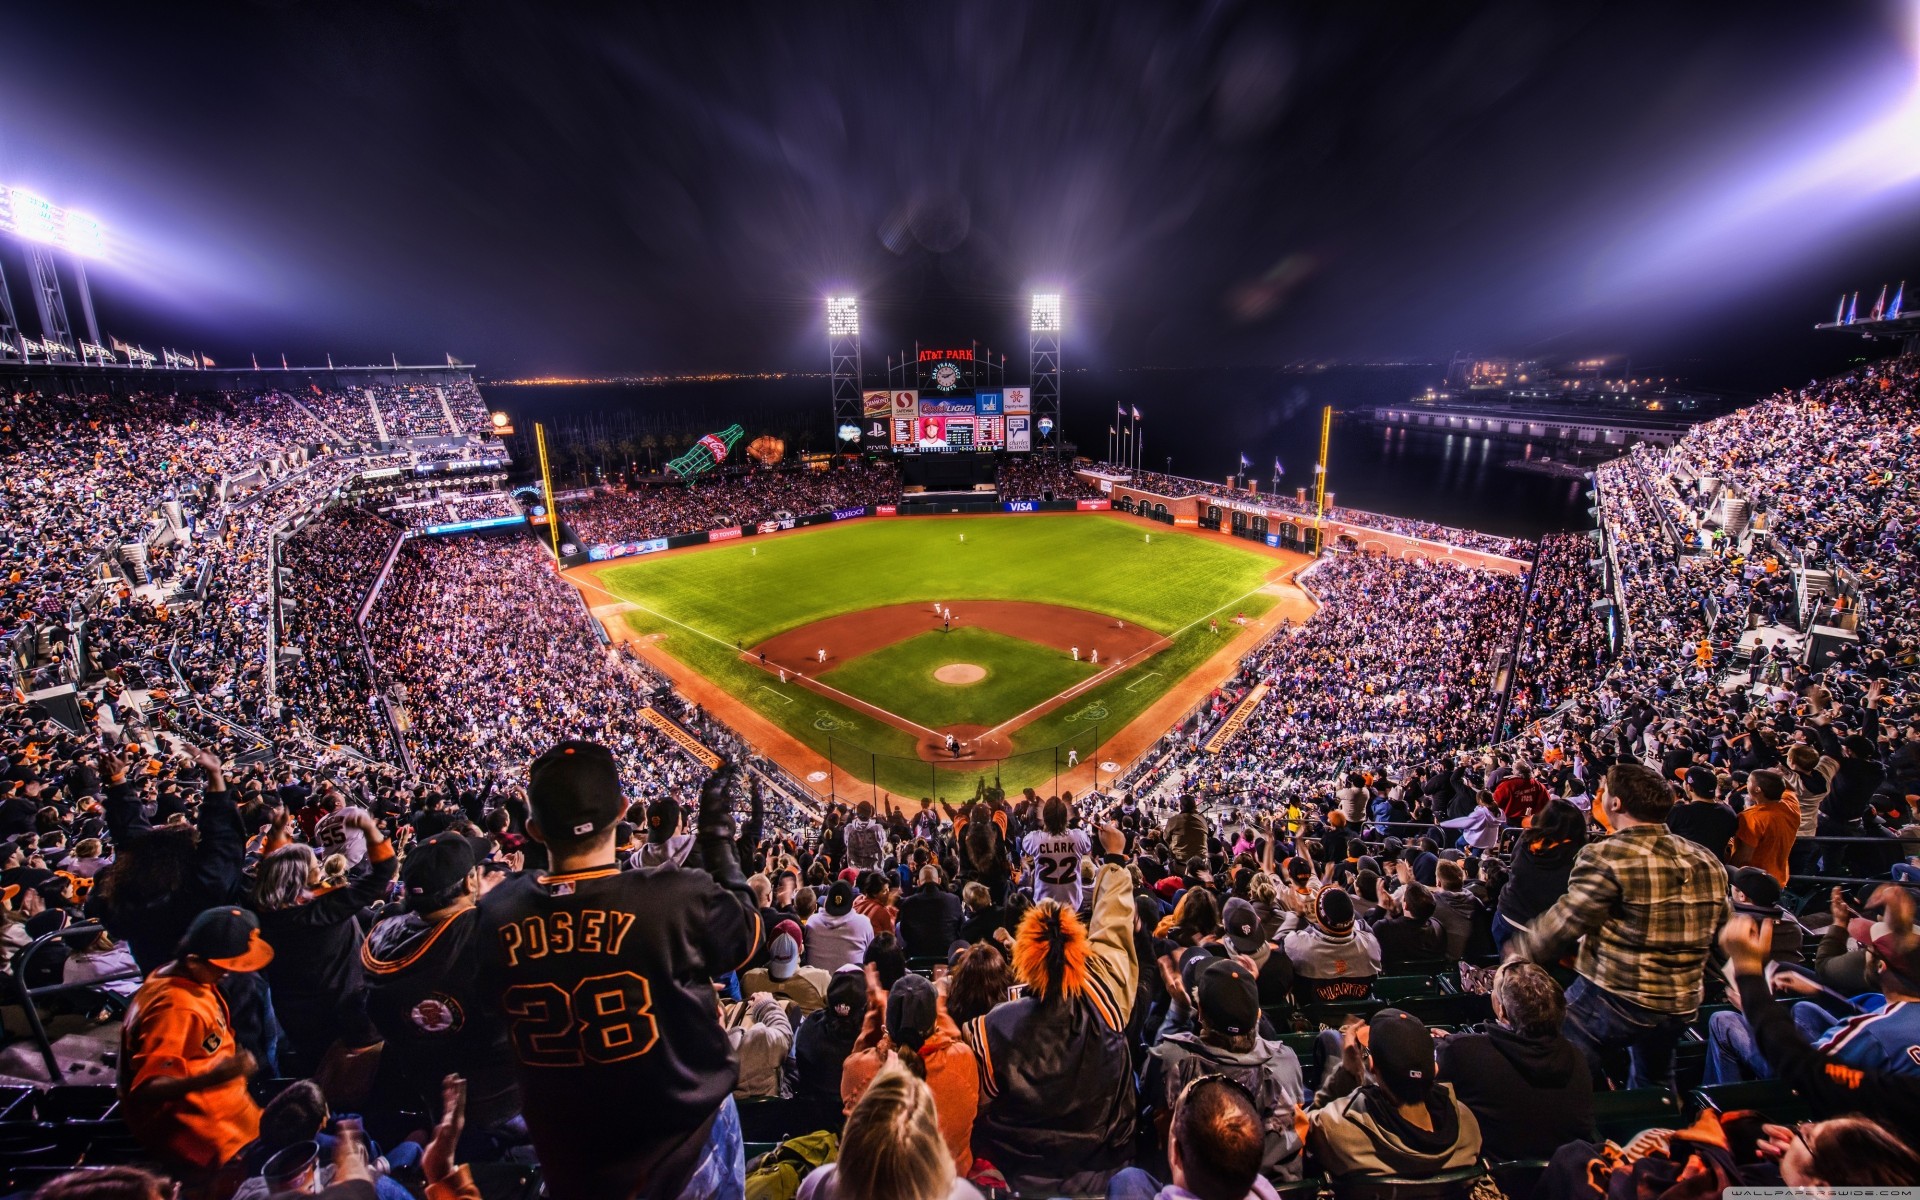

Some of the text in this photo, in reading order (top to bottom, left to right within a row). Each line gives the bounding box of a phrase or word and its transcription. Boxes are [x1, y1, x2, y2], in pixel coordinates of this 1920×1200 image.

[919, 349, 973, 361] AT&T PARK
[931, 362, 960, 379] SAN FRANCISCO
[865, 398, 889, 407] DIAMOND
[921, 403, 973, 413] Coors LIGHT
[1010, 502, 1033, 511] VISA
[1231, 503, 1267, 516] LANDING
[719, 529, 741, 537] TOYOTA
[648, 714, 661, 725] SAN
[659, 720, 691, 744] FRANCISCO
[685, 741, 711, 760] GIANTS
[320, 825, 347, 847] 55
[1040, 842, 1075, 853] CLARK
[1038, 856, 1078, 885] 22
[498, 909, 636, 967] POSEY
[502, 970, 660, 1067] 28
